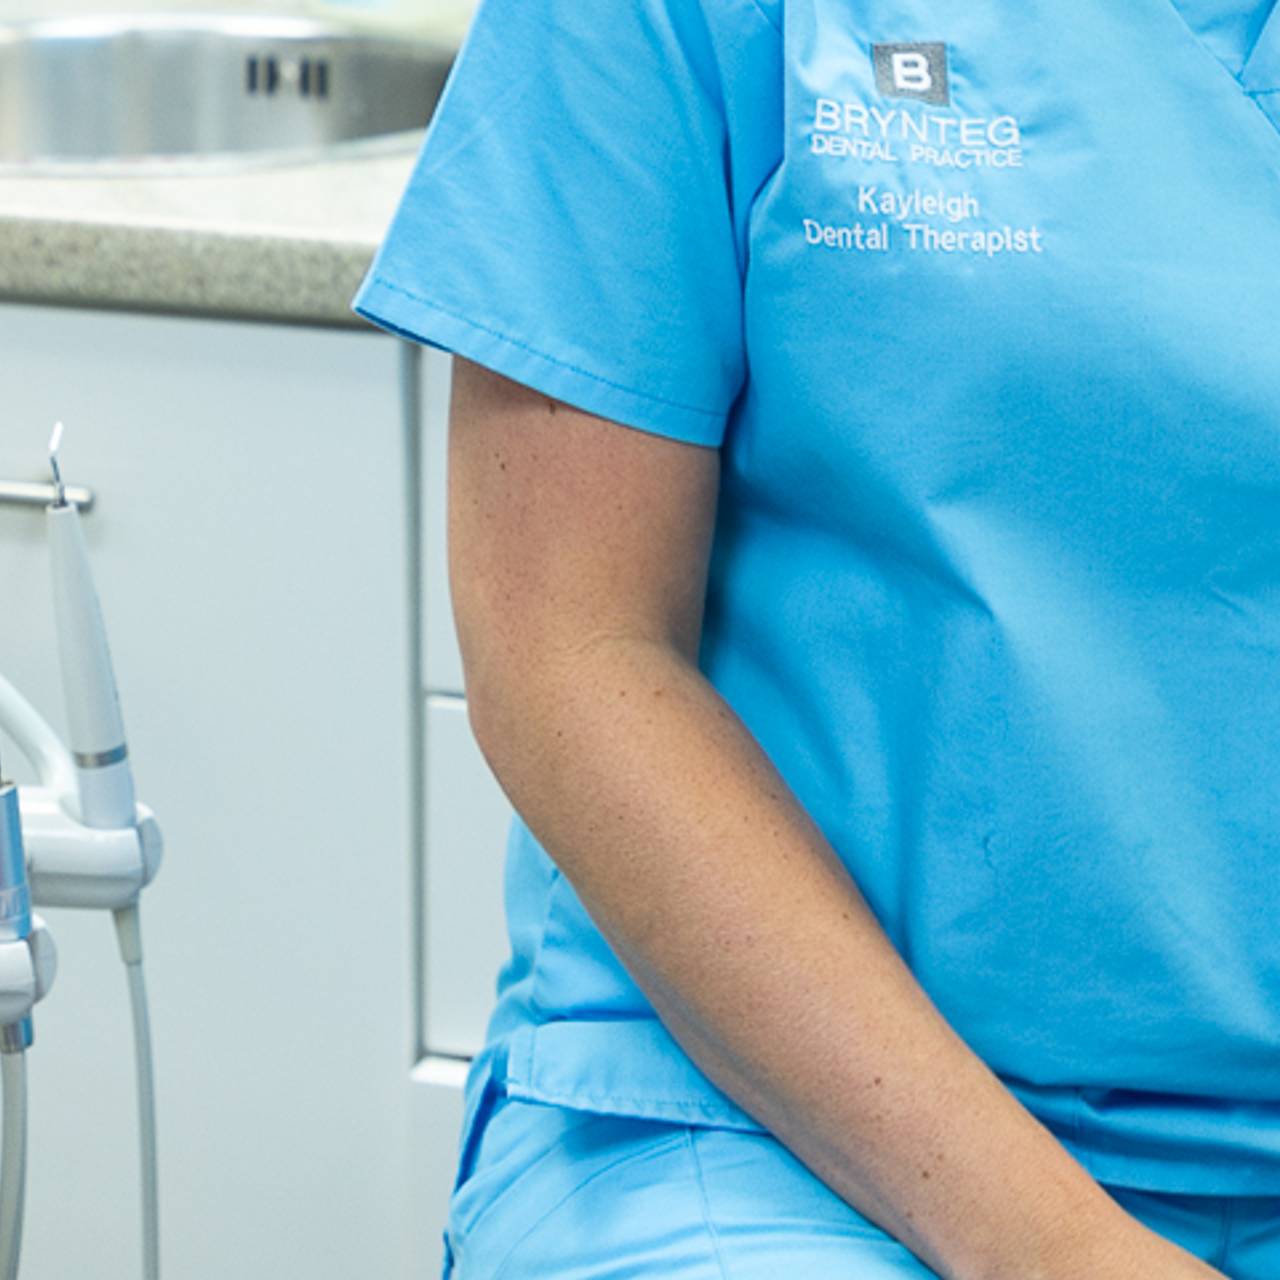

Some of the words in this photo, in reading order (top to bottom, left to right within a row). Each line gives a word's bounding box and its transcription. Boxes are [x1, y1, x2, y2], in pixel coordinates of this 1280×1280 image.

[893, 54, 931, 90] B
[815, 99, 1020, 146] BRYNTEG
[812, 135, 896, 161] DENTAL
[911, 145, 1022, 169] PRACTICE
[858, 187, 978, 220] Kayleigh
[804, 220, 888, 250] Dental
[904, 225, 1041, 255] Therapist
